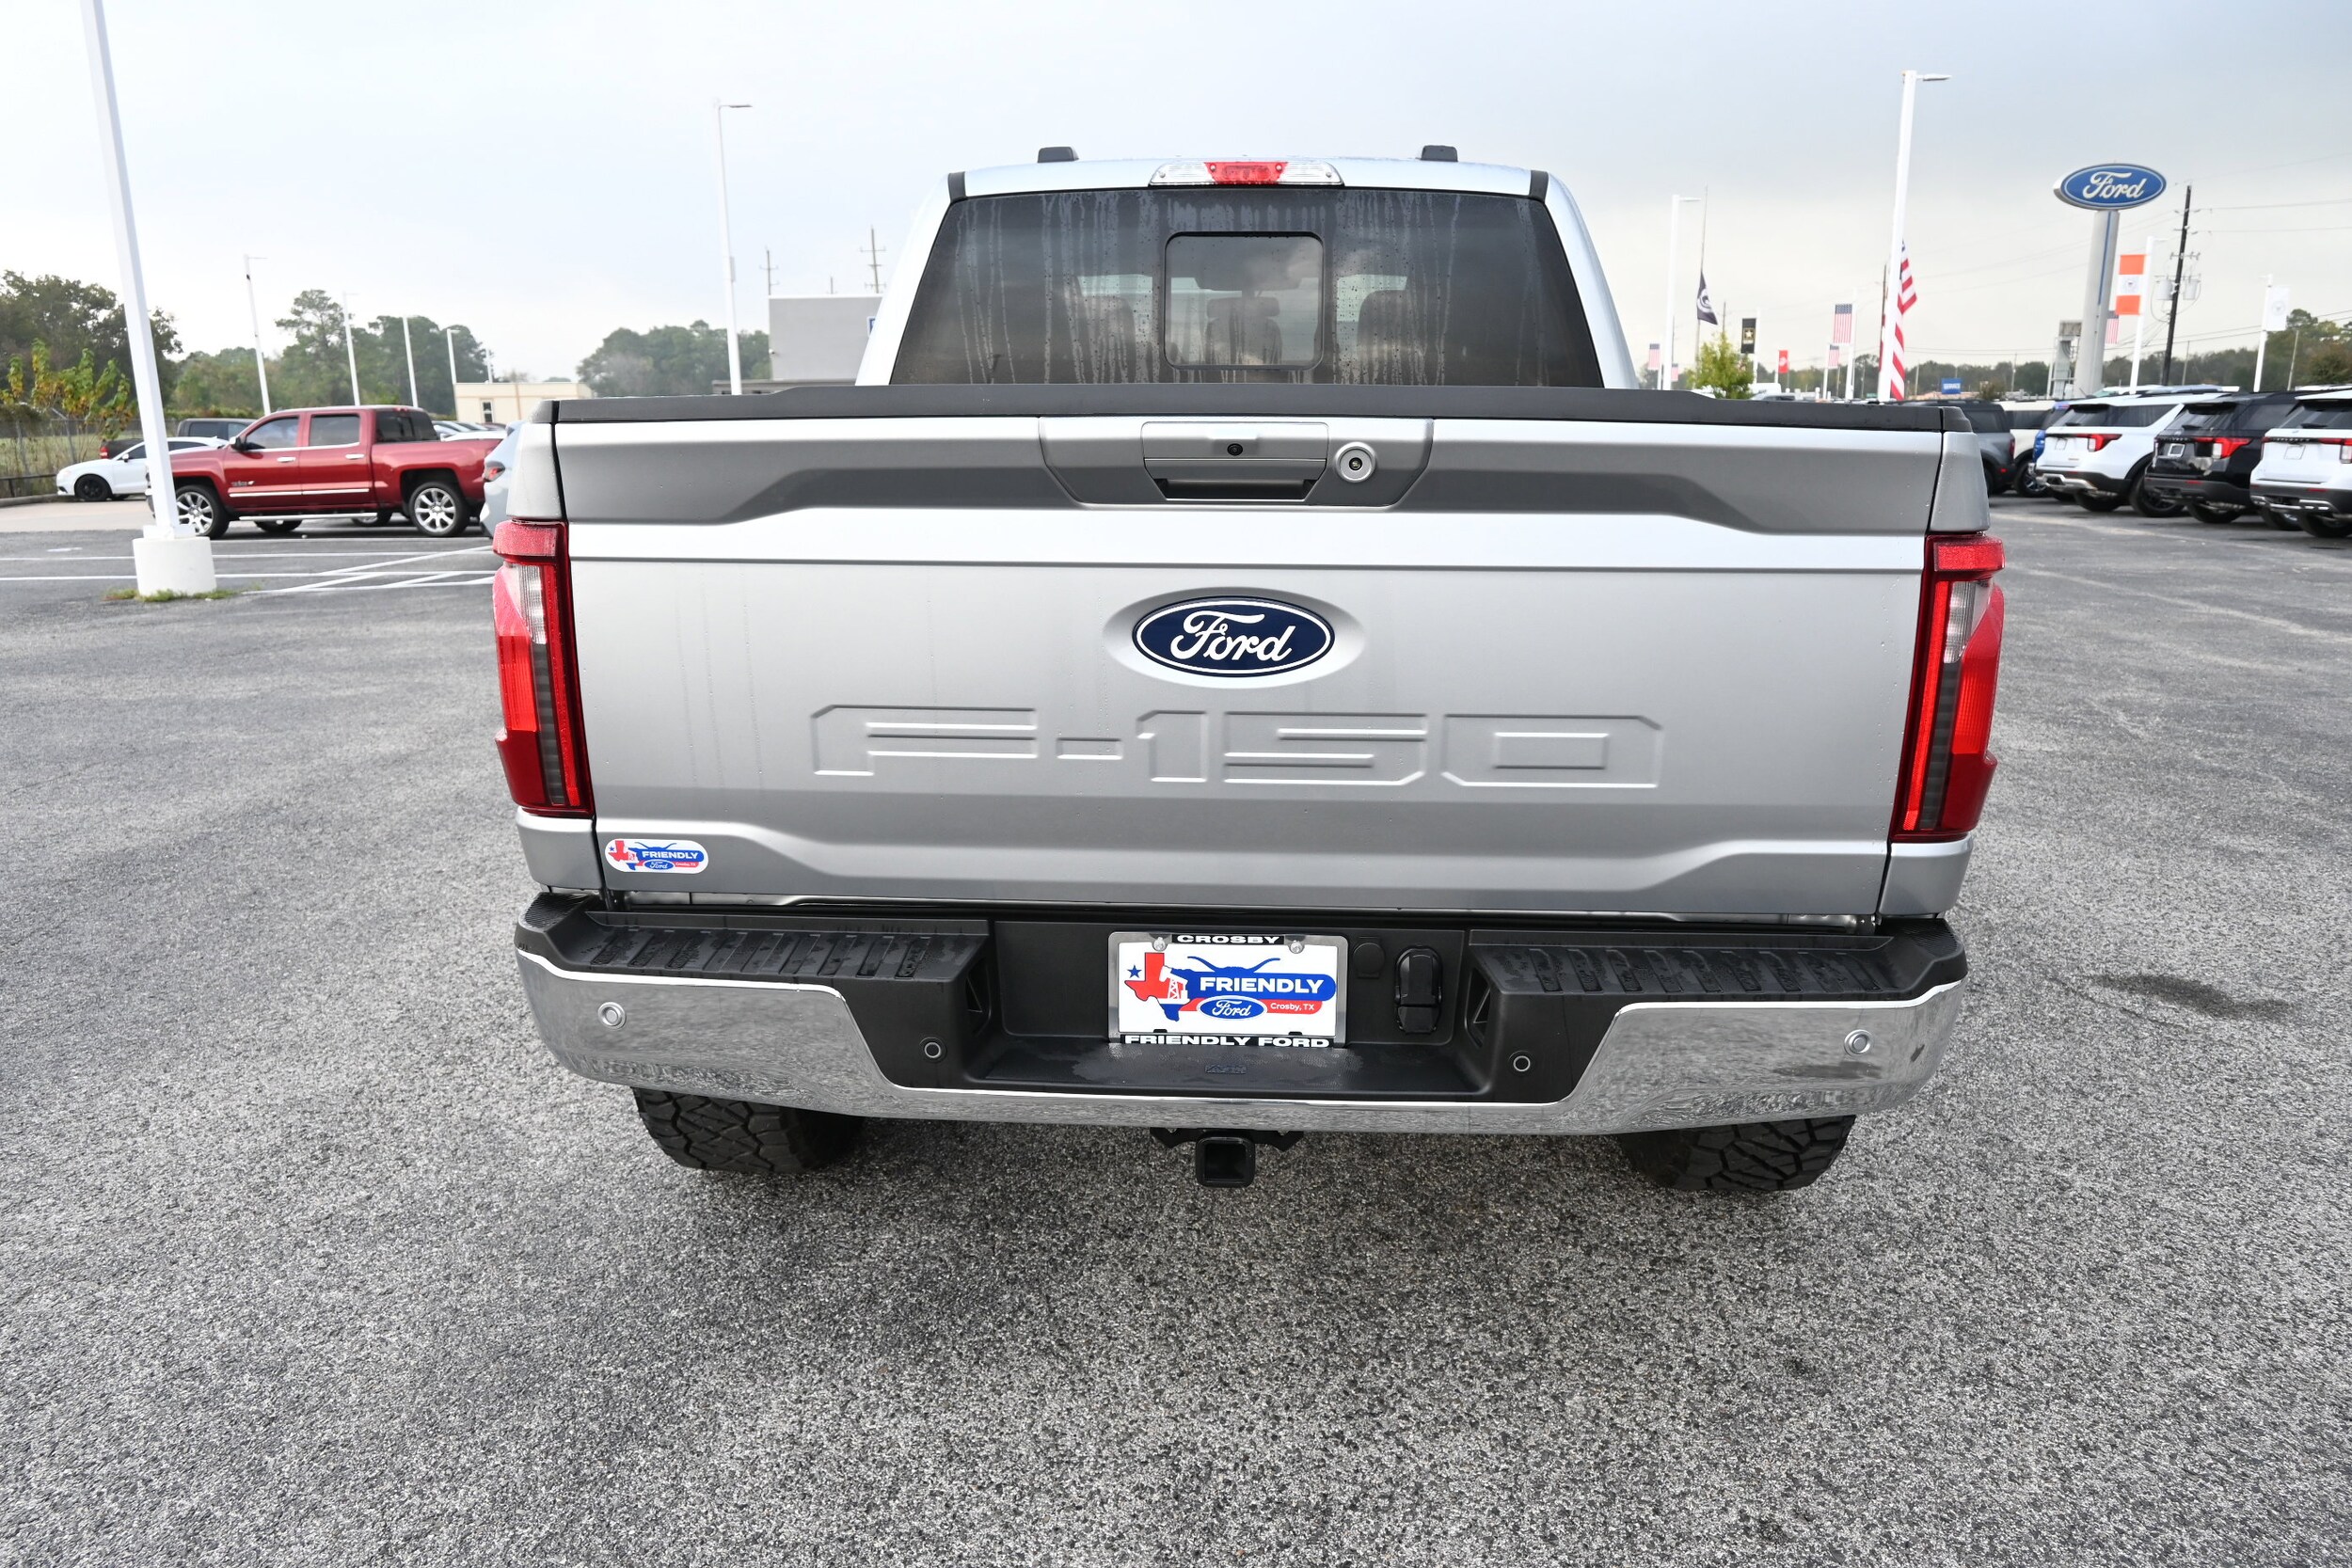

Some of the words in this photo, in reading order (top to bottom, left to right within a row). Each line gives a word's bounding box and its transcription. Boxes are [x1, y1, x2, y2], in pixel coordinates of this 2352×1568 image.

[2082, 171, 2148, 198] Ford
[1170, 610, 1296, 661] Ford
[810, 704, 1663, 788] F-150
[642, 850, 699, 860] FRIENDLY
[649, 861, 669, 869] Ford
[1177, 935, 1279, 944] CROSBY
[1200, 976, 1325, 994] FRIENDLY
[1212, 999, 1252, 1017] Ford
[1270, 1002, 1302, 1011] Crosby,
[1304, 1003, 1315, 1011] TX
[1124, 1035, 1250, 1047] FRIENDLY
[1259, 1037, 1330, 1048] FORD
